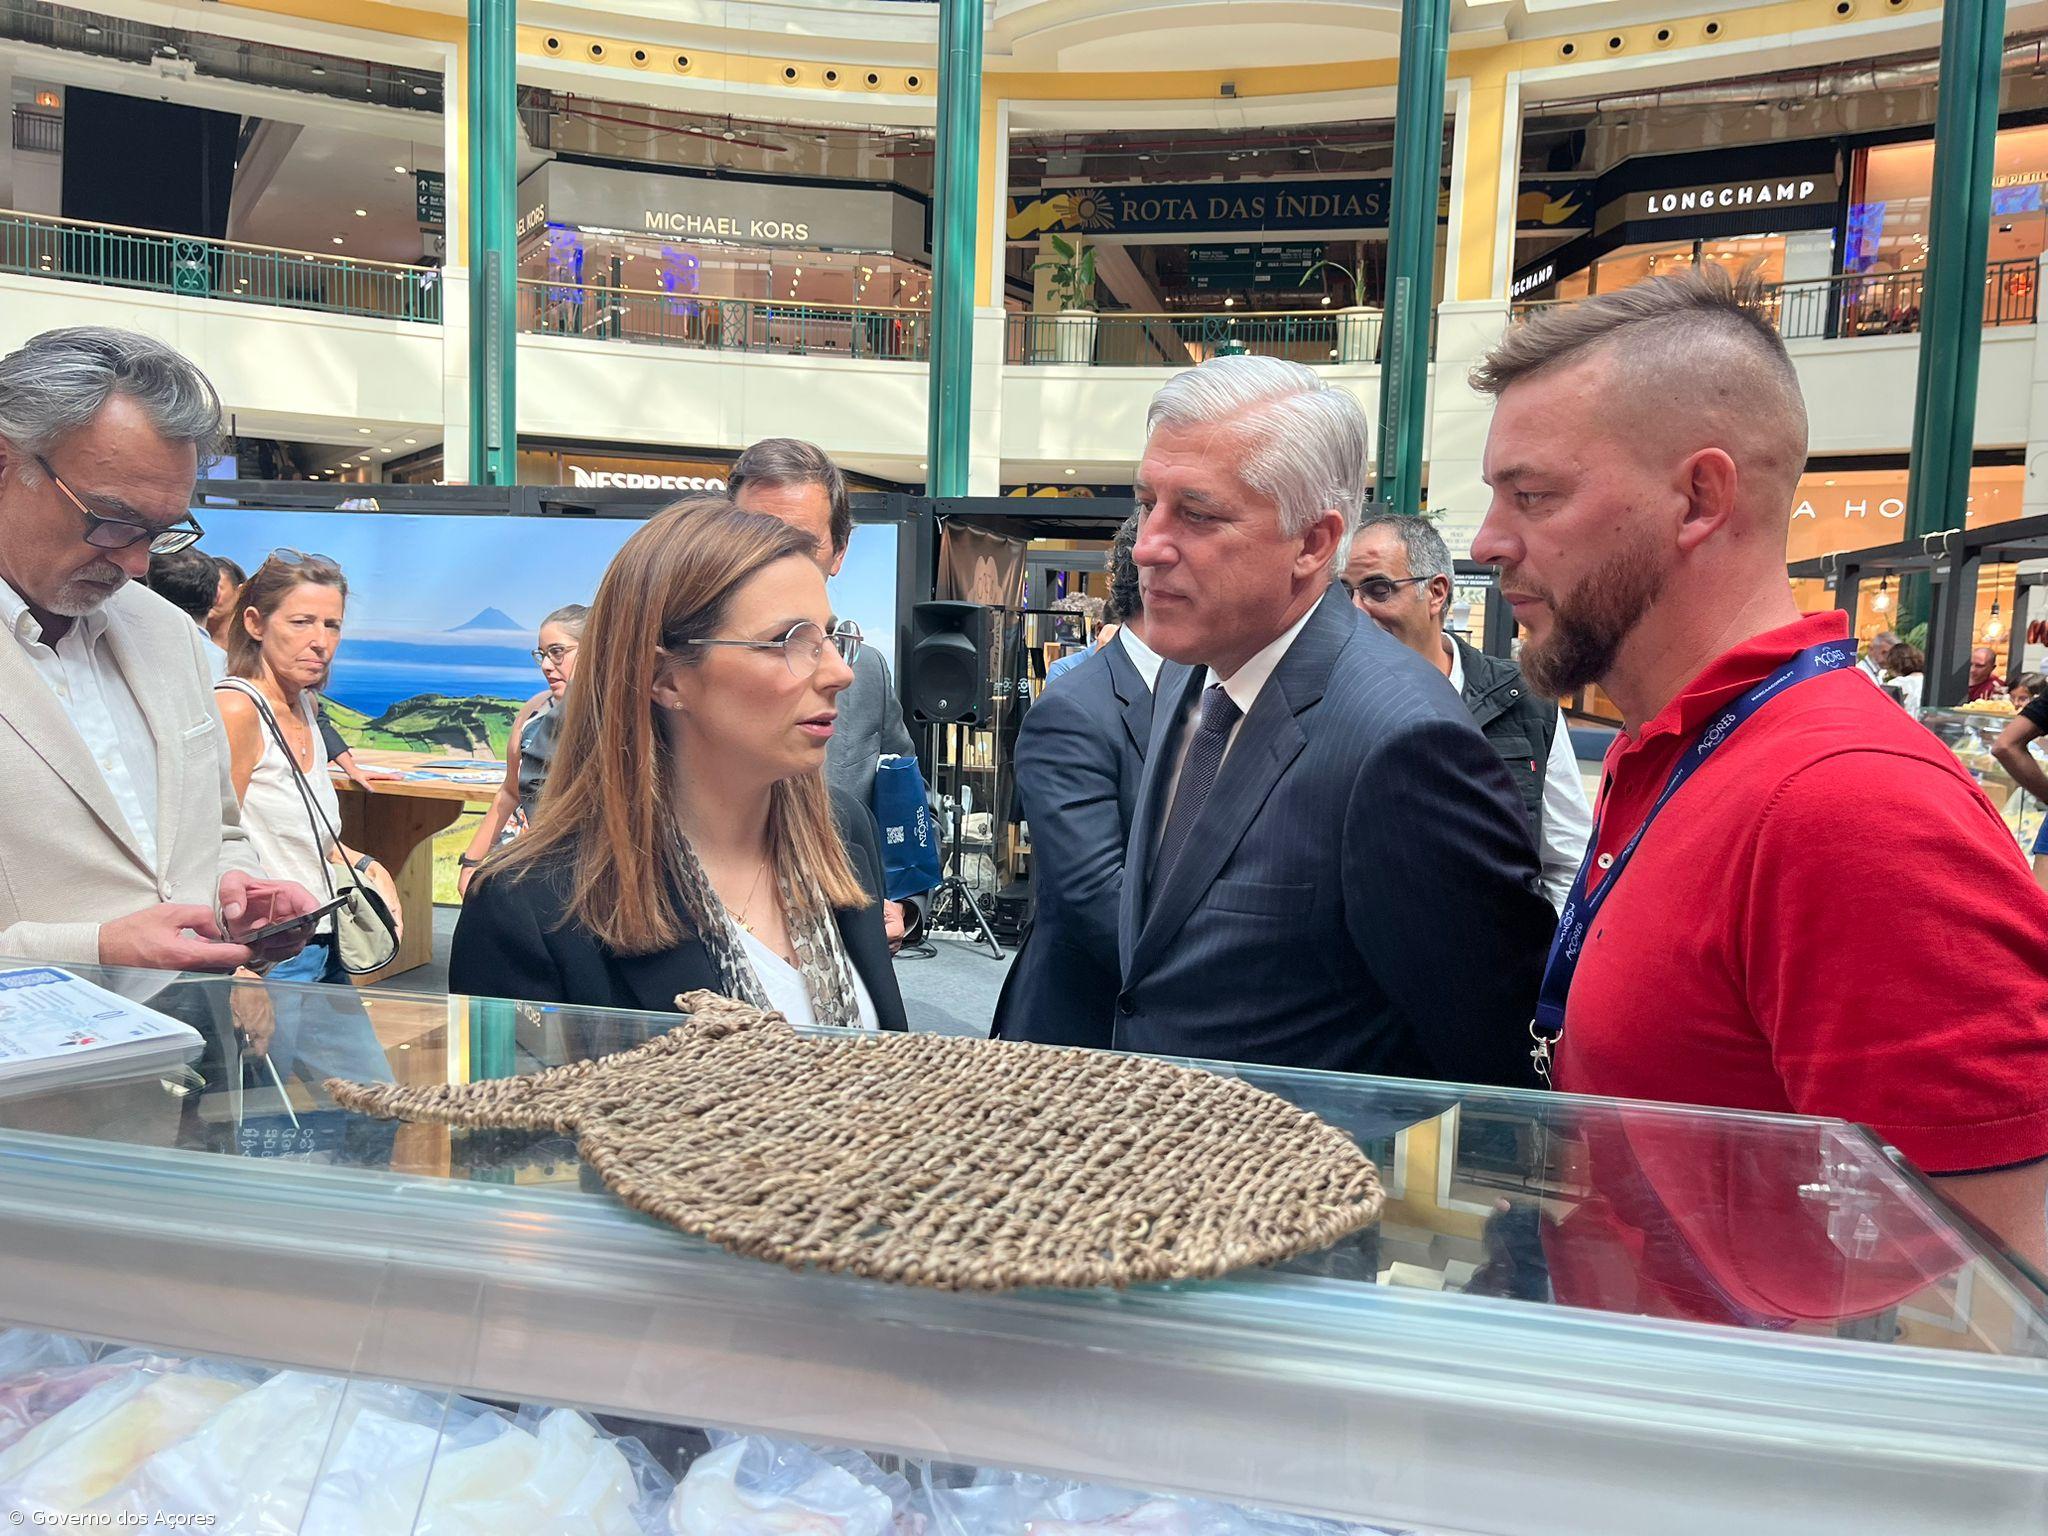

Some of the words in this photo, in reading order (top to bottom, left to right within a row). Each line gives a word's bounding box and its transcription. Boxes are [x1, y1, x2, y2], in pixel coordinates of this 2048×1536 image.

[1121, 198, 1198, 222] ROTA
[1207, 196, 1265, 219] DAS
[1275, 189, 1380, 218] ÍNDIAS
[1647, 180, 1815, 215] LONGCHAMP
[645, 210, 742, 237] MICHAEL
[750, 220, 809, 241] KORS
[1697, 713, 1736, 755] AÇORES
